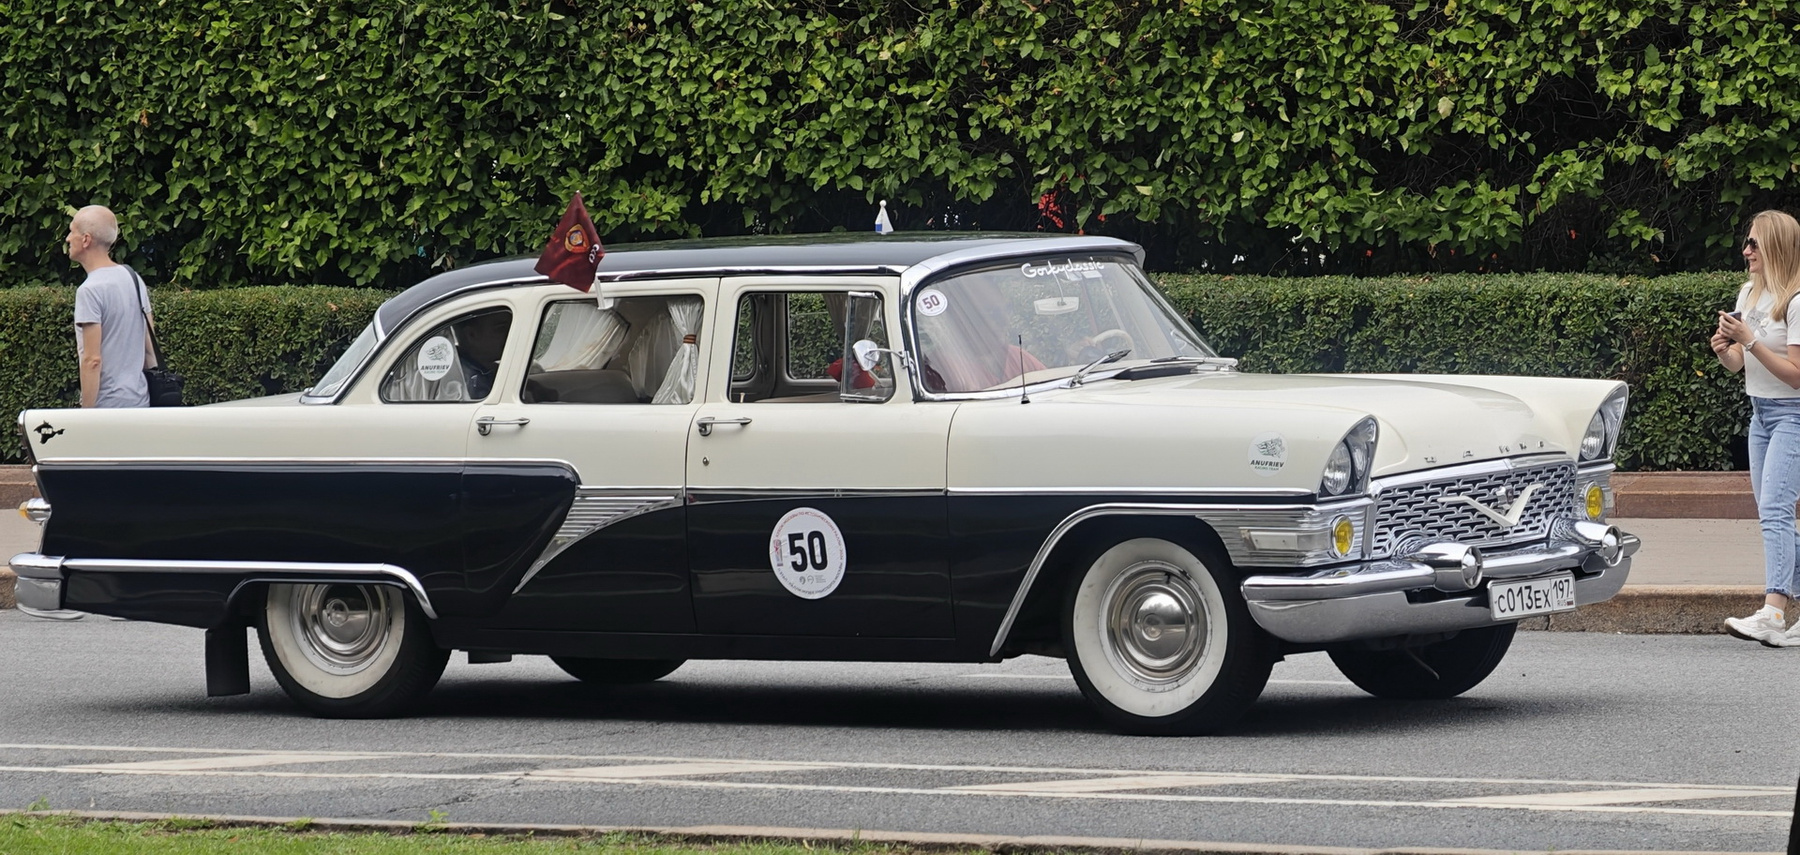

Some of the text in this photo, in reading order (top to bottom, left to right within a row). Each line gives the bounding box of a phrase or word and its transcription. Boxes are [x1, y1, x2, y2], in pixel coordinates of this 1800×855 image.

[1021, 256, 1104, 279] Gorkyclassic
[922, 295, 940, 309] 50
[788, 531, 828, 572] 50
[1553, 579, 1570, 599] 197
